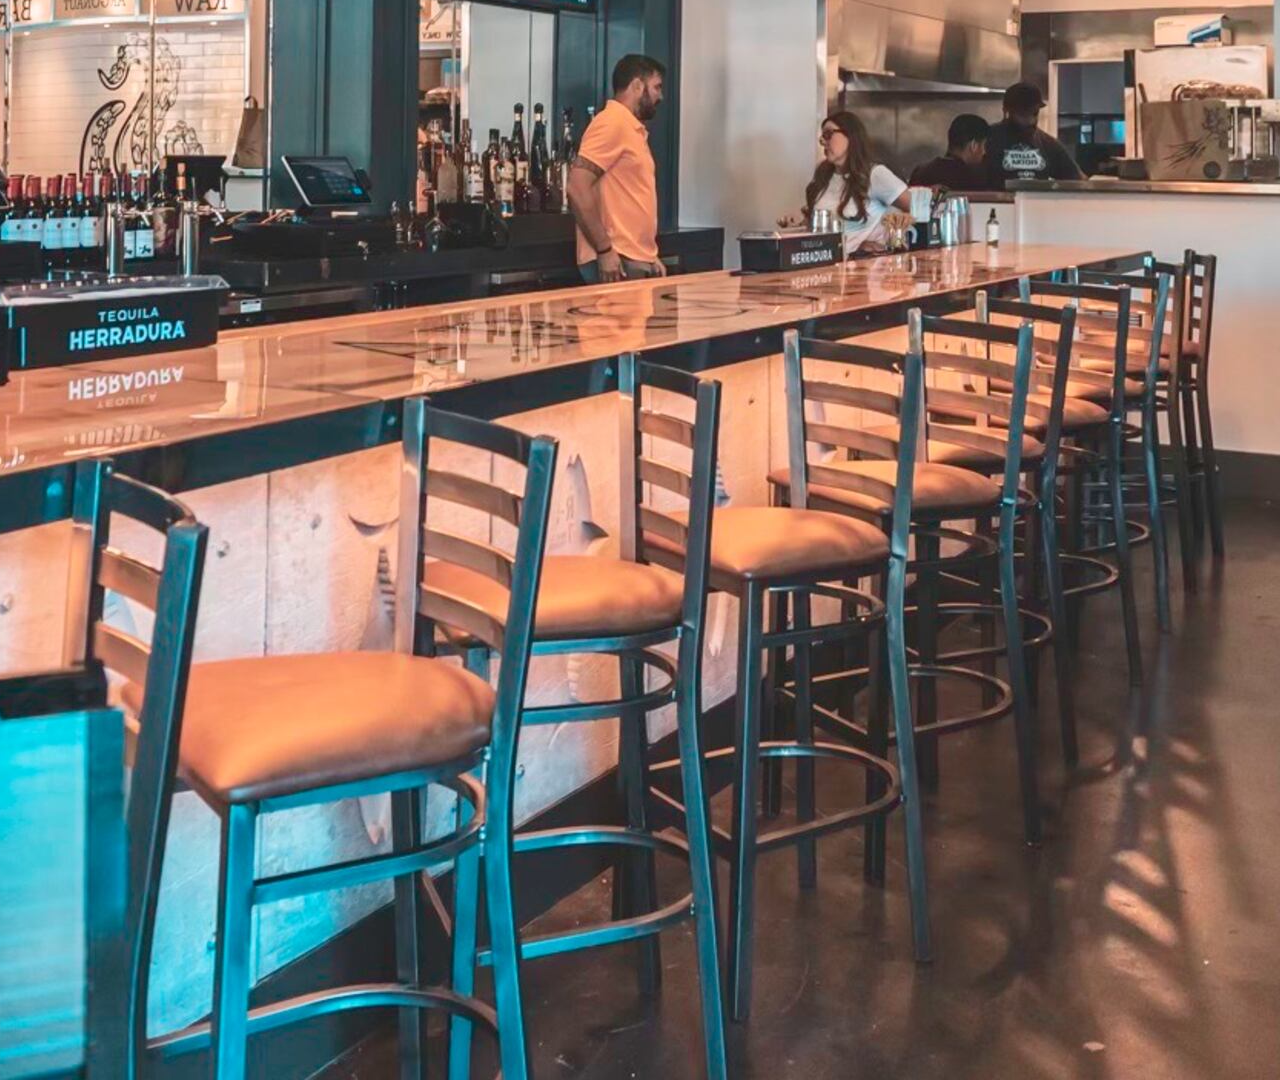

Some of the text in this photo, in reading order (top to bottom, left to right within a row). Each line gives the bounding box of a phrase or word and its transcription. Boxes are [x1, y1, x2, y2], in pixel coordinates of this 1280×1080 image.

[791, 249, 833, 265] HERRADURA
[98, 306, 159, 323] TEQUILA
[69, 320, 186, 351] HERRADURA
